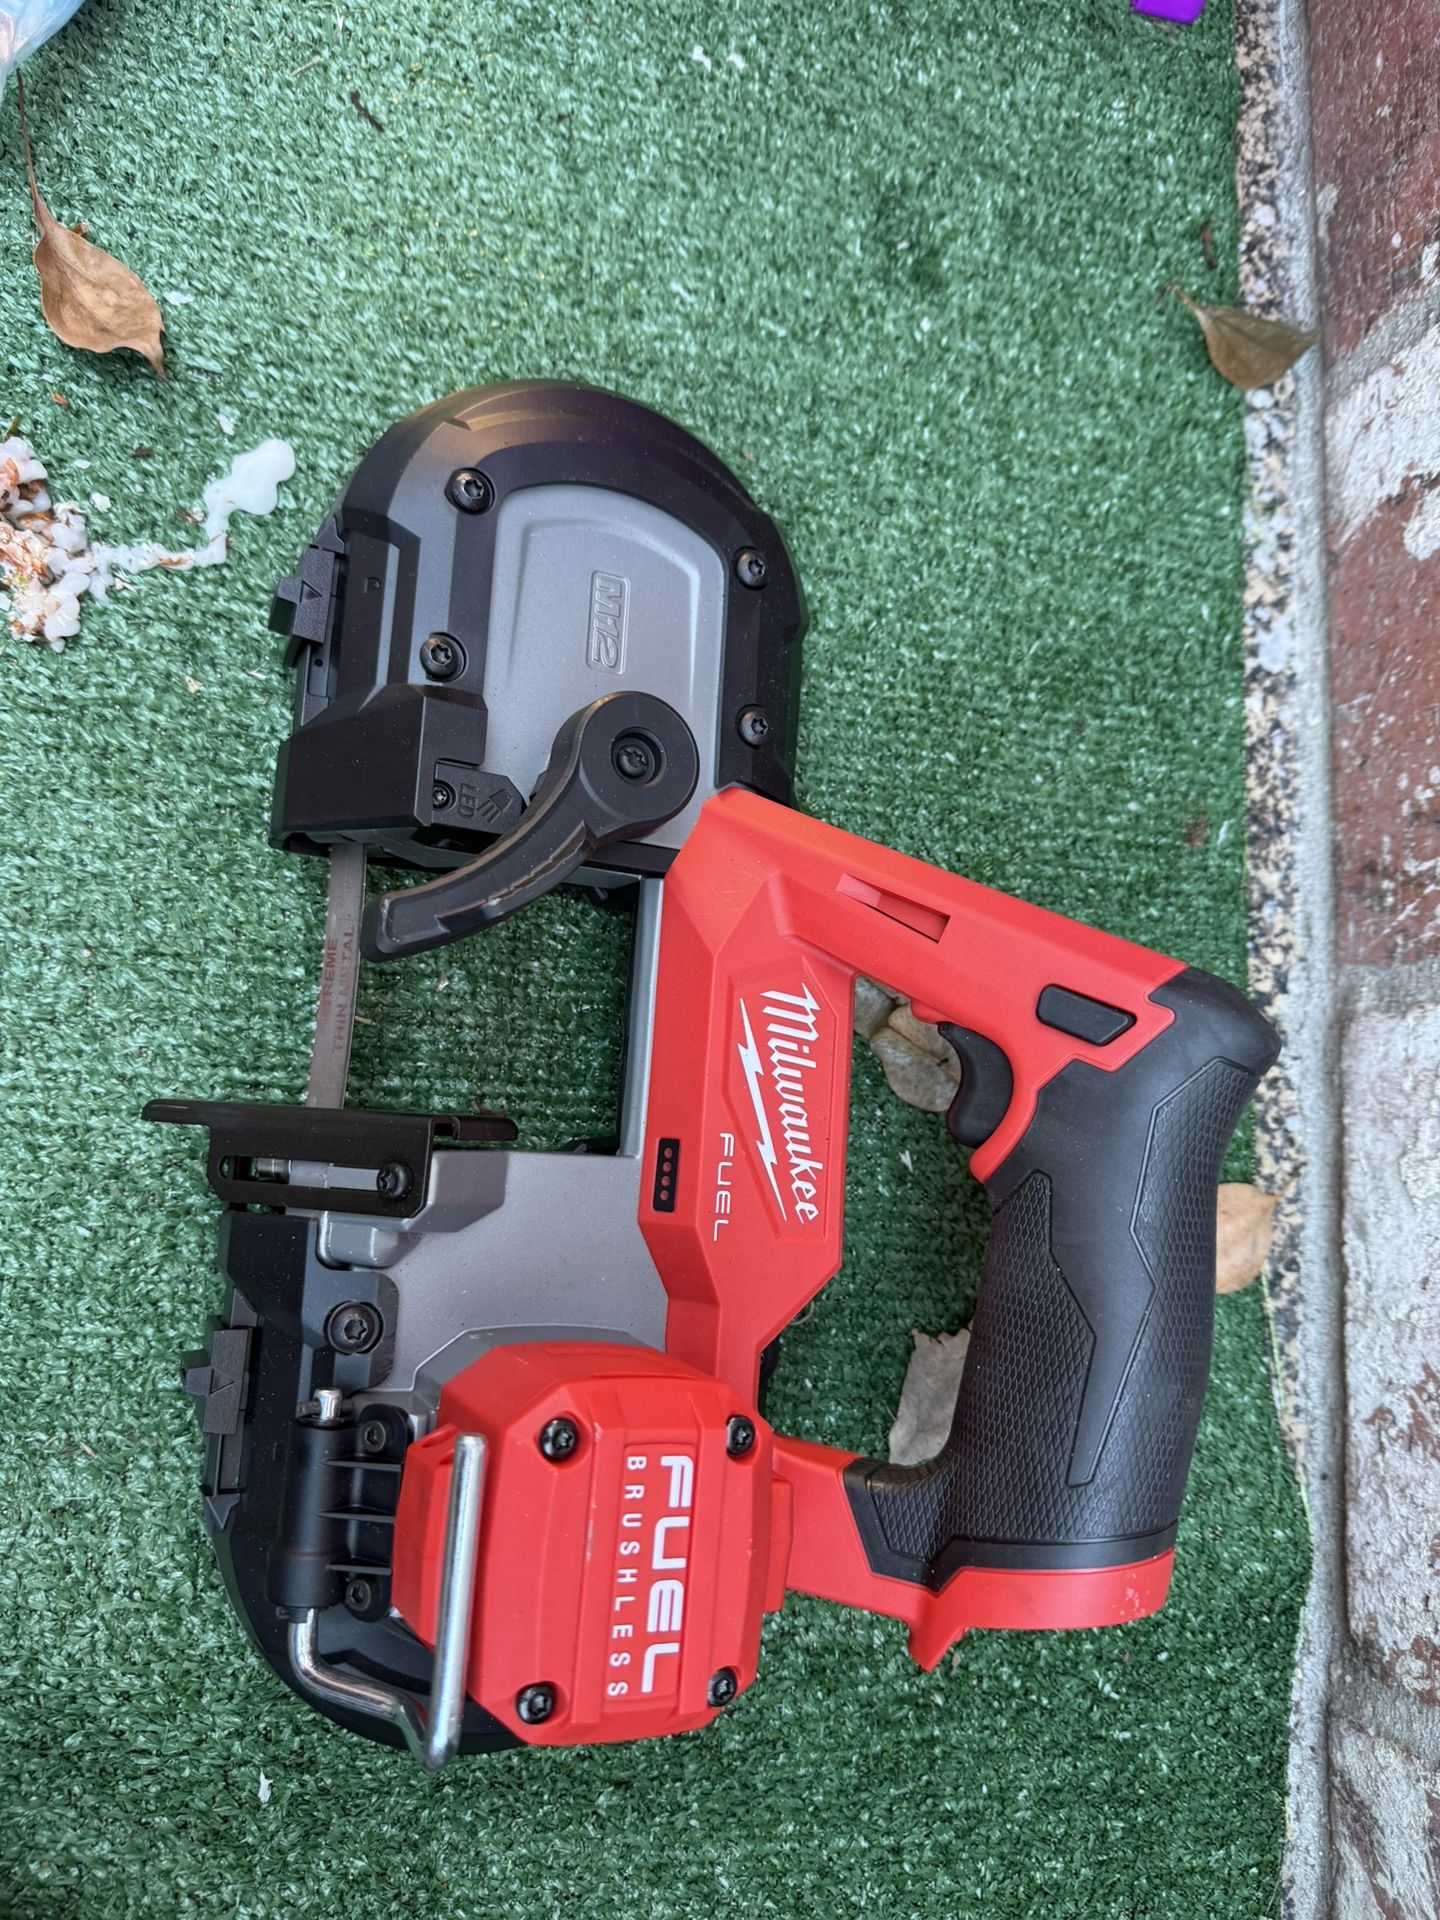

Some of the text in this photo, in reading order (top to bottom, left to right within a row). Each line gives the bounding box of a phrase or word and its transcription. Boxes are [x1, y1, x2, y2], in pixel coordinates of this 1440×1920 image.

[591, 577, 622, 668] M12
[459, 782, 479, 819] LED
[332, 1003, 347, 1053] THIN
[760, 982, 821, 1225] Milwaukee
[713, 1132, 735, 1242] FUEL
[607, 1456, 647, 1696] BRUSHLESS
[641, 1455, 694, 1693] FUEL
